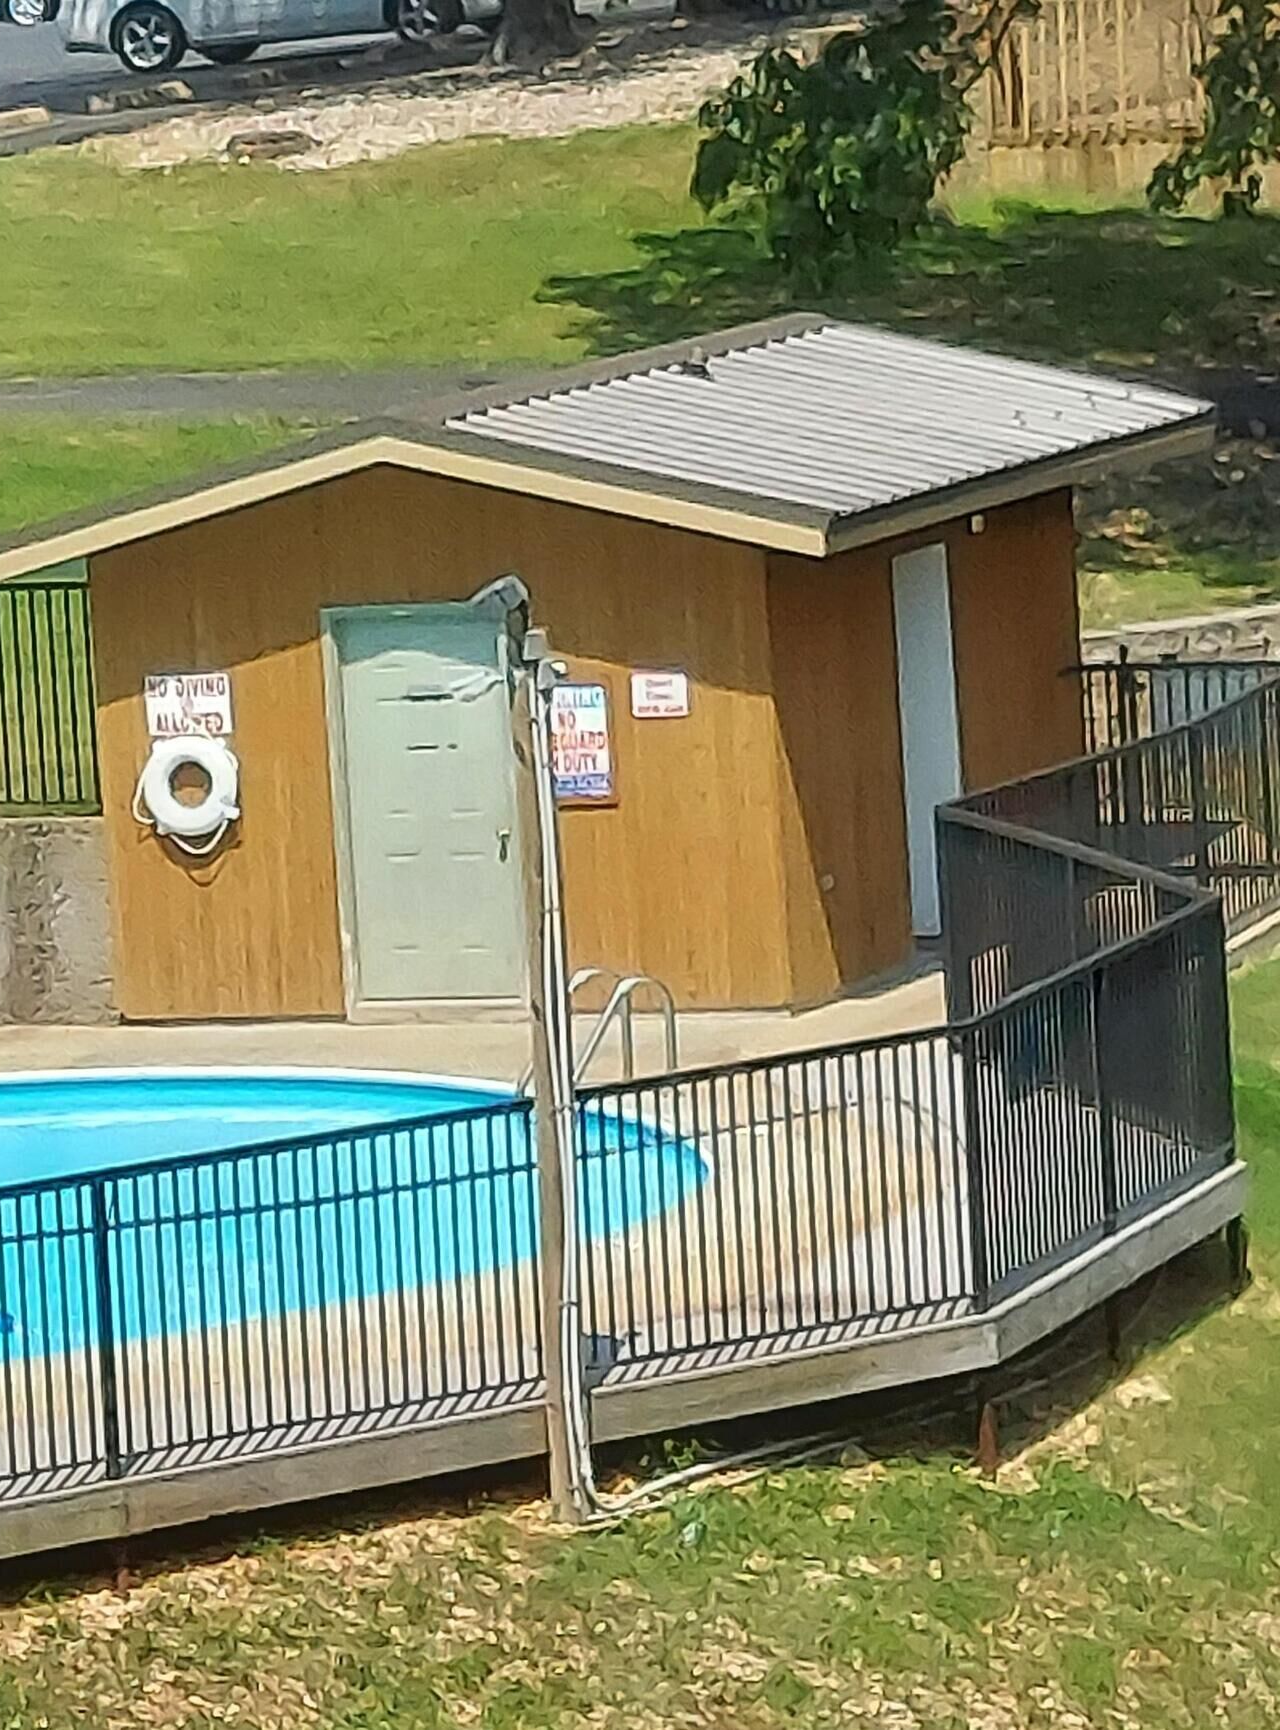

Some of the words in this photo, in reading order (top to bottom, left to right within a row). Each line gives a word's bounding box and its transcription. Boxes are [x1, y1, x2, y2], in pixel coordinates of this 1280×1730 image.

[148, 677, 167, 697] NO
[176, 676, 225, 697] DIVING
[557, 710, 576, 729] NO
[564, 753, 597, 772] DUTY
